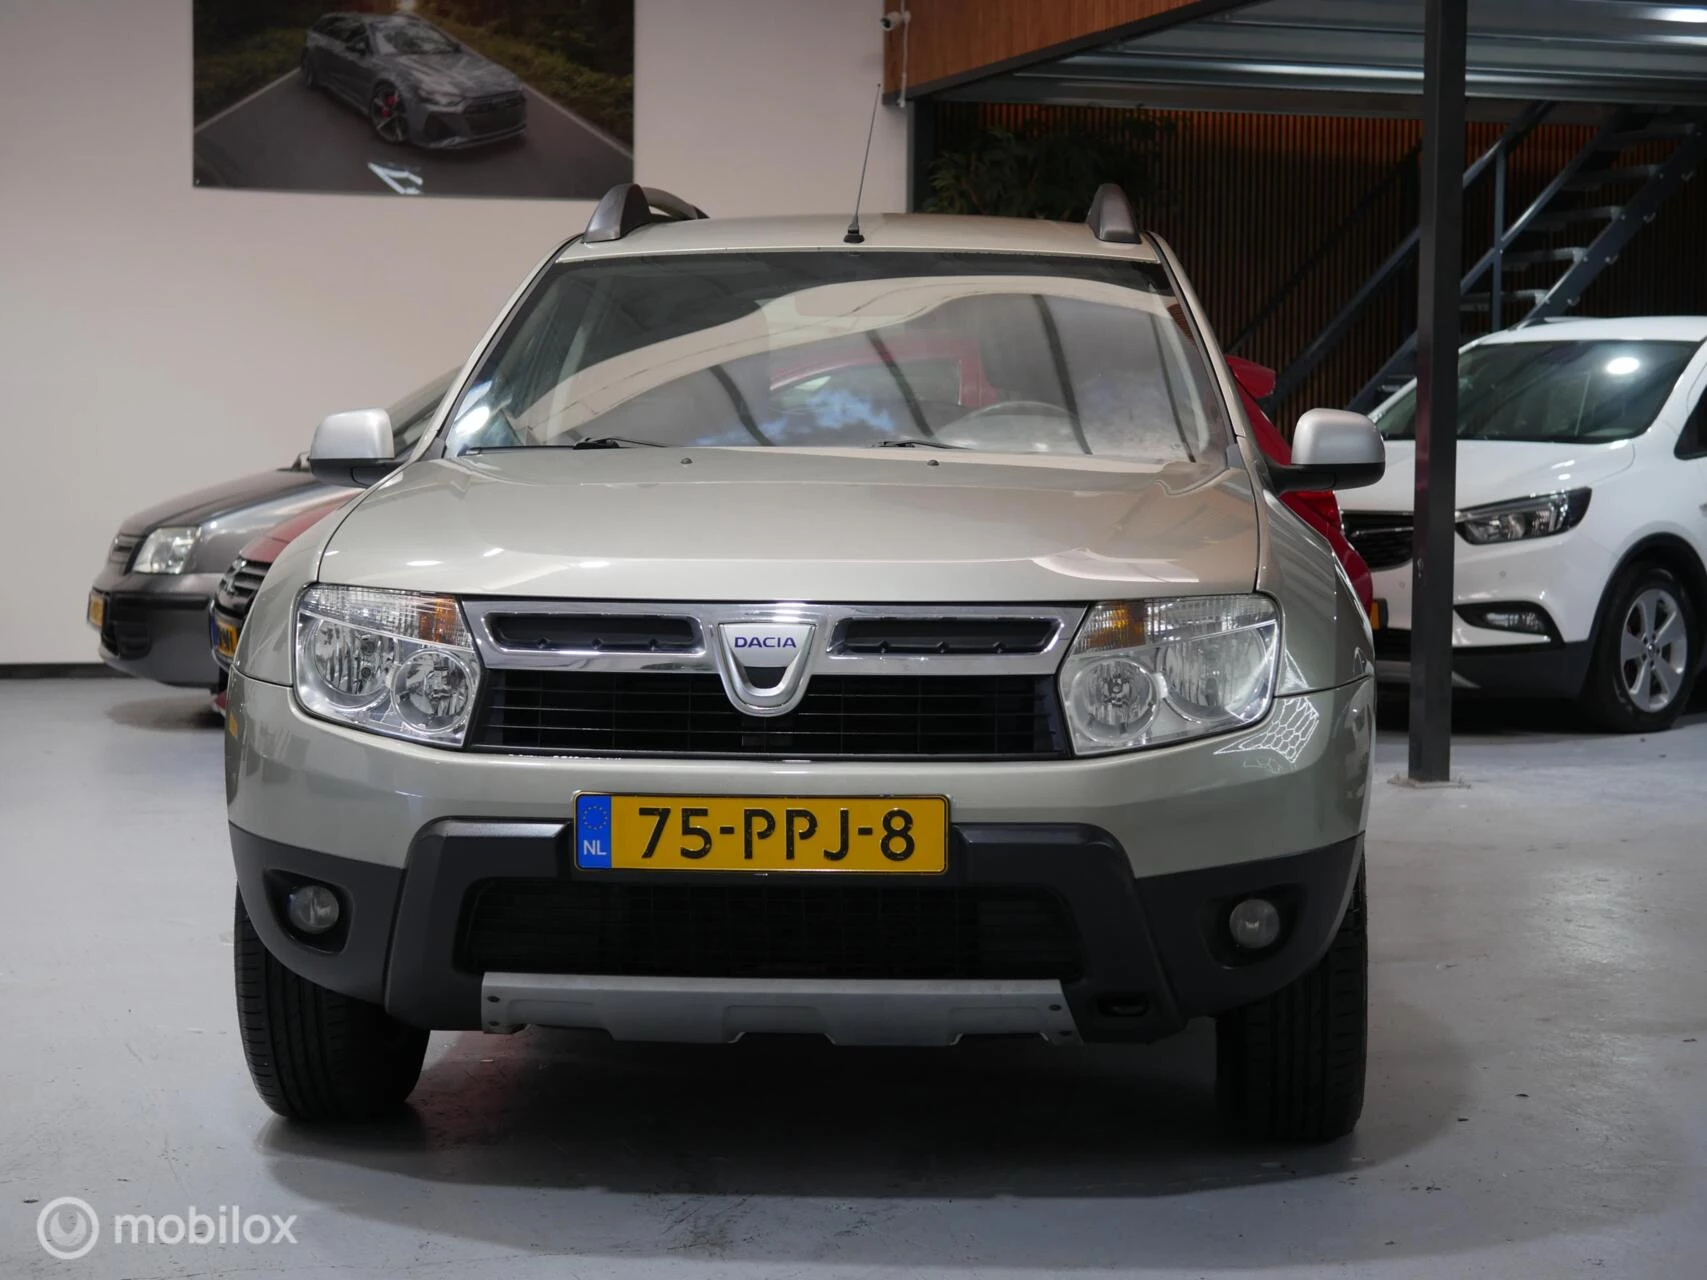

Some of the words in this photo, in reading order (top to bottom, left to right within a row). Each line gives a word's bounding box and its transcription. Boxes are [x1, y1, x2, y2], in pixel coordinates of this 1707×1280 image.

[734, 636, 797, 649] DACIA
[637, 807, 916, 862] 75-PPJ-8
[583, 839, 608, 856] NL
